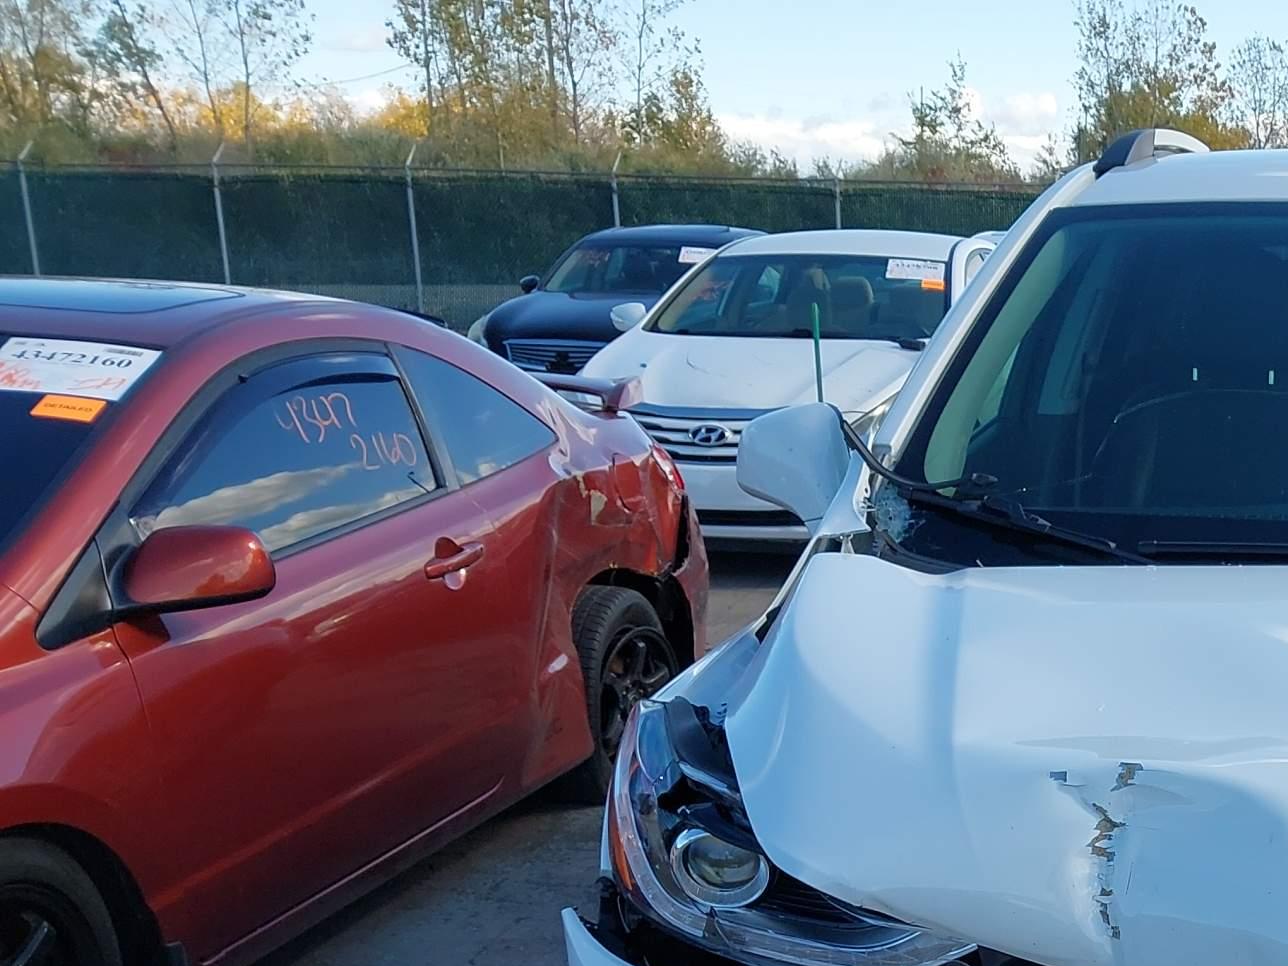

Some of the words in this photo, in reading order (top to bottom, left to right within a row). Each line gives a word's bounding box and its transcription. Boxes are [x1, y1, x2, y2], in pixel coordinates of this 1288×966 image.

[11, 350, 133, 368] 43472160
[43, 402, 94, 412] DETAILED
[274, 393, 357, 443] 4347
[351, 432, 417, 470] 2160
